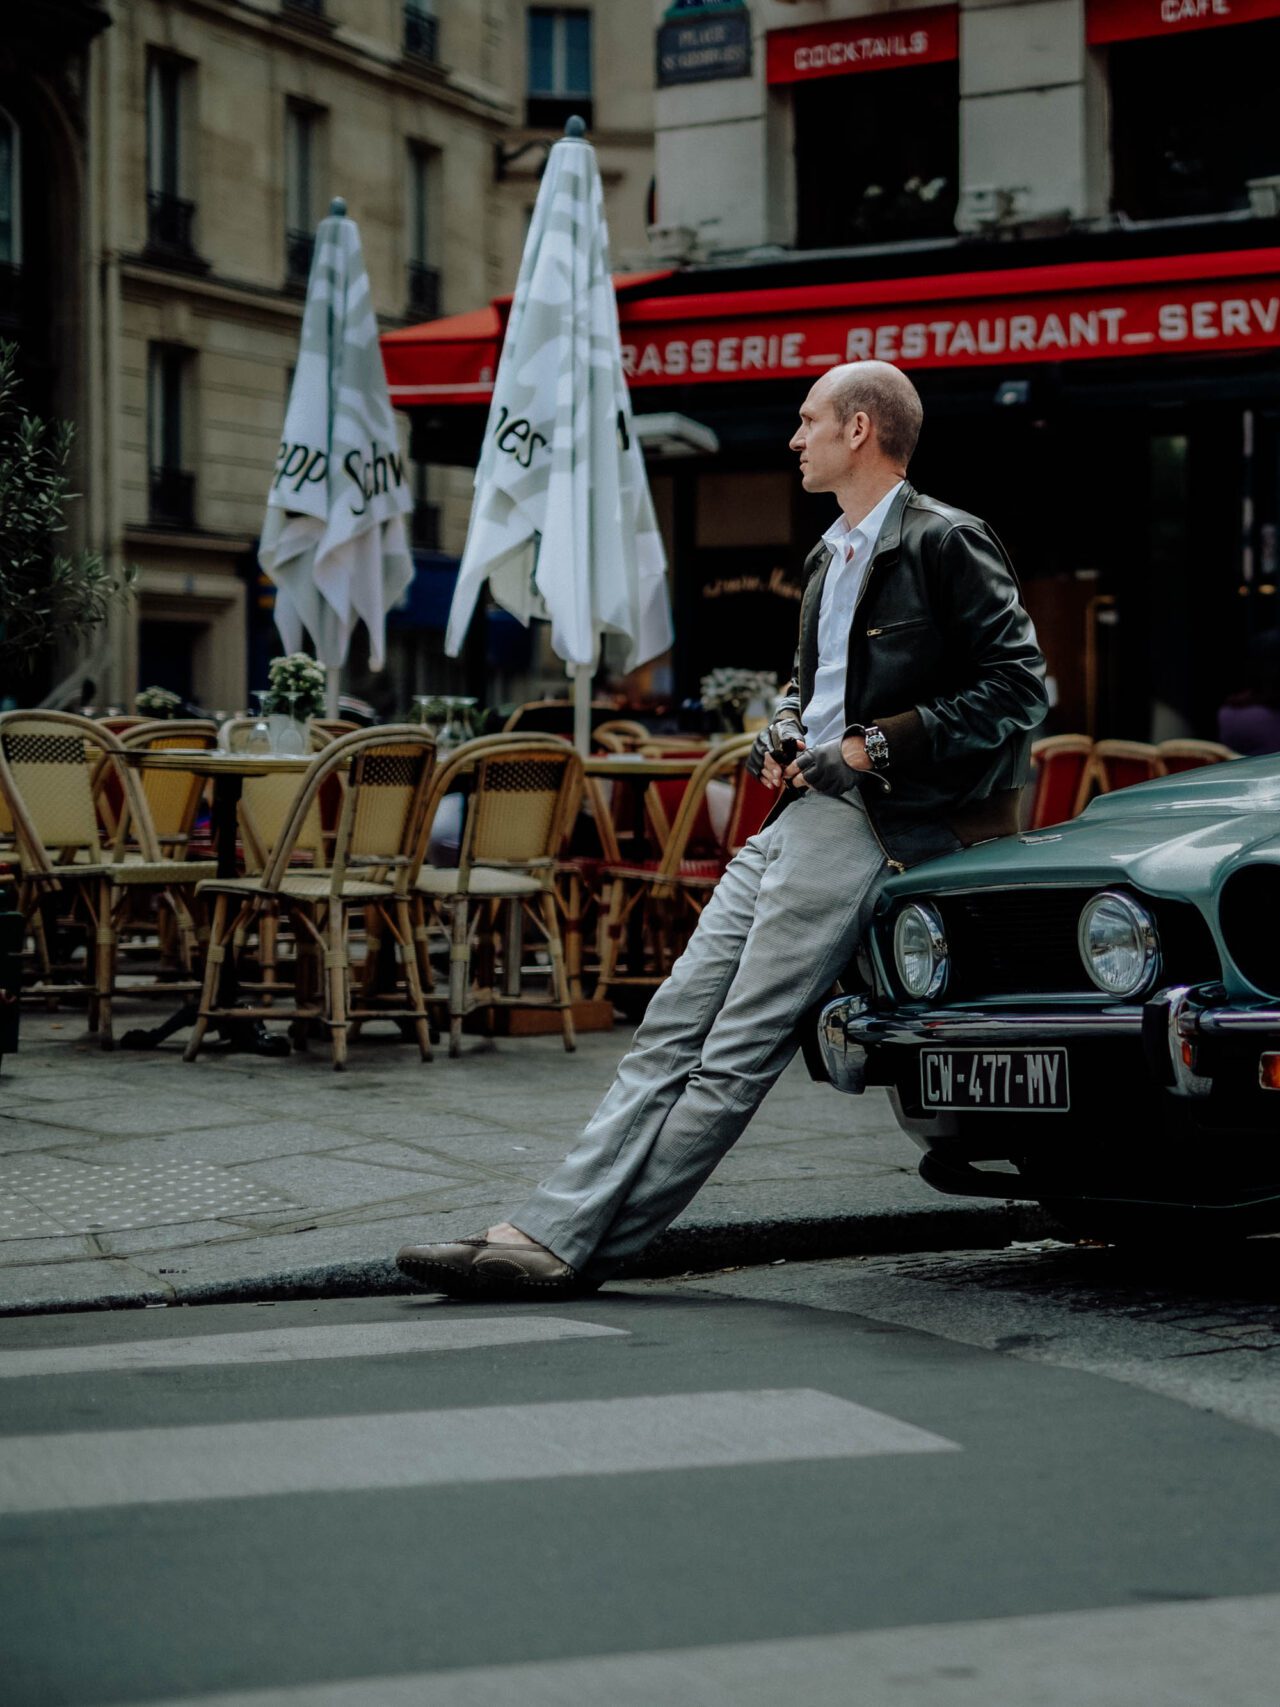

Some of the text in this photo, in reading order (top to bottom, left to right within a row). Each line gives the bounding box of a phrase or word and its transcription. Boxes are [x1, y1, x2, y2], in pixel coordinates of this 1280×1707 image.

[794, 31, 928, 70] COCKTAILS
[620, 334, 804, 376] RASSERIE
[848, 308, 1127, 363] RESTAURANT
[926, 1053, 1060, 1105] CW-477-MY
